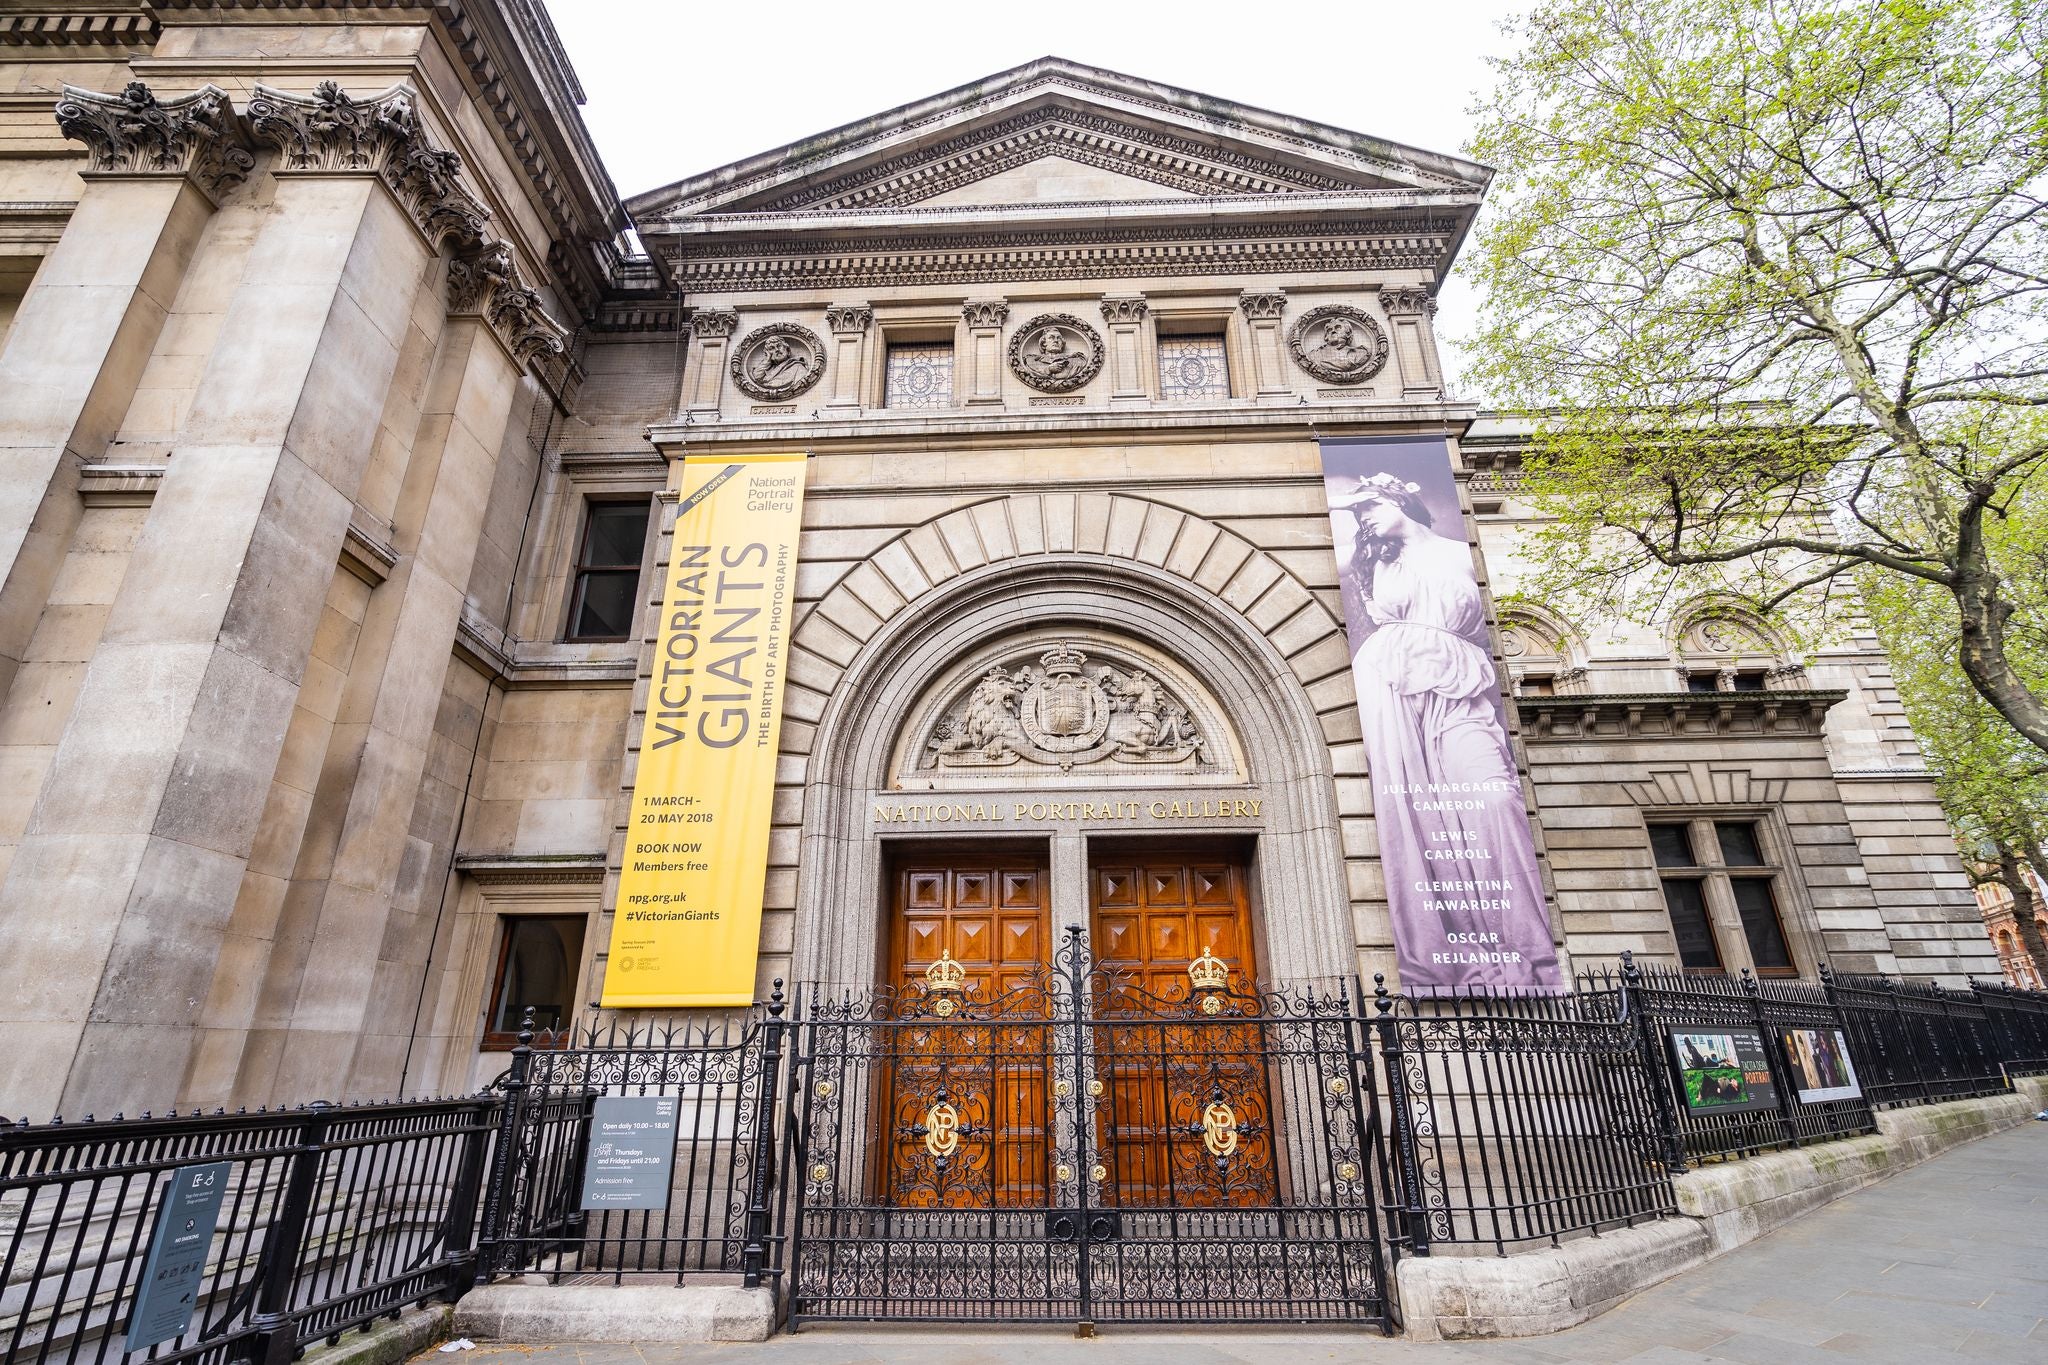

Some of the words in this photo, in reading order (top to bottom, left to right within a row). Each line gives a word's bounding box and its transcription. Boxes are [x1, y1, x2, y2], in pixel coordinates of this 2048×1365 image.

[749, 476, 796, 487] National
[691, 488, 709, 504] NOW
[708, 474, 727, 491] OPEN
[748, 488, 794, 499] Portrait
[746, 500, 793, 513] Gallery
[770, 543, 789, 632] PHOTOGRAPHY
[652, 545, 712, 751] VICTORIAN
[697, 542, 769, 749] GIANTS
[768, 634, 780, 659] ART
[766, 660, 777, 678] OF
[760, 682, 774, 720] BIRTH
[757, 721, 771, 748] THE
[1382, 783, 1424, 795] JULIA
[1428, 781, 1509, 794] MARGARET
[643, 797, 649, 806] 1
[650, 796, 693, 806] MARCH
[1412, 800, 1486, 811] CAMERON
[874, 803, 1004, 823] NATIONAL
[1013, 801, 1140, 821] PORTRAIT
[1150, 800, 1263, 819] GALLERY
[640, 814, 655, 824] 20
[657, 813, 685, 823] MAY
[686, 813, 713, 823] 2018
[1431, 831, 1478, 842] LEWIS
[636, 843, 670, 853] BOOK
[672, 843, 702, 853] NOW
[1424, 848, 1492, 860] CARROLL
[633, 861, 684, 871] Members
[686, 861, 709, 871] free
[1414, 880, 1513, 892] CLEMENTINA
[628, 892, 687, 905] npg.org.uk
[1423, 900, 1512, 911] HAWARDEN
[626, 910, 720, 921] #VictorianGiants
[1447, 932, 1499, 944] OSCAR
[1432, 951, 1522, 964] REJLANDER
[1744, 1071, 1770, 1085] PORTRAIT
[618, 1122, 632, 1130] daily
[609, 1157, 630, 1165] Fridays
[181, 1233, 200, 1241] SMOKING
